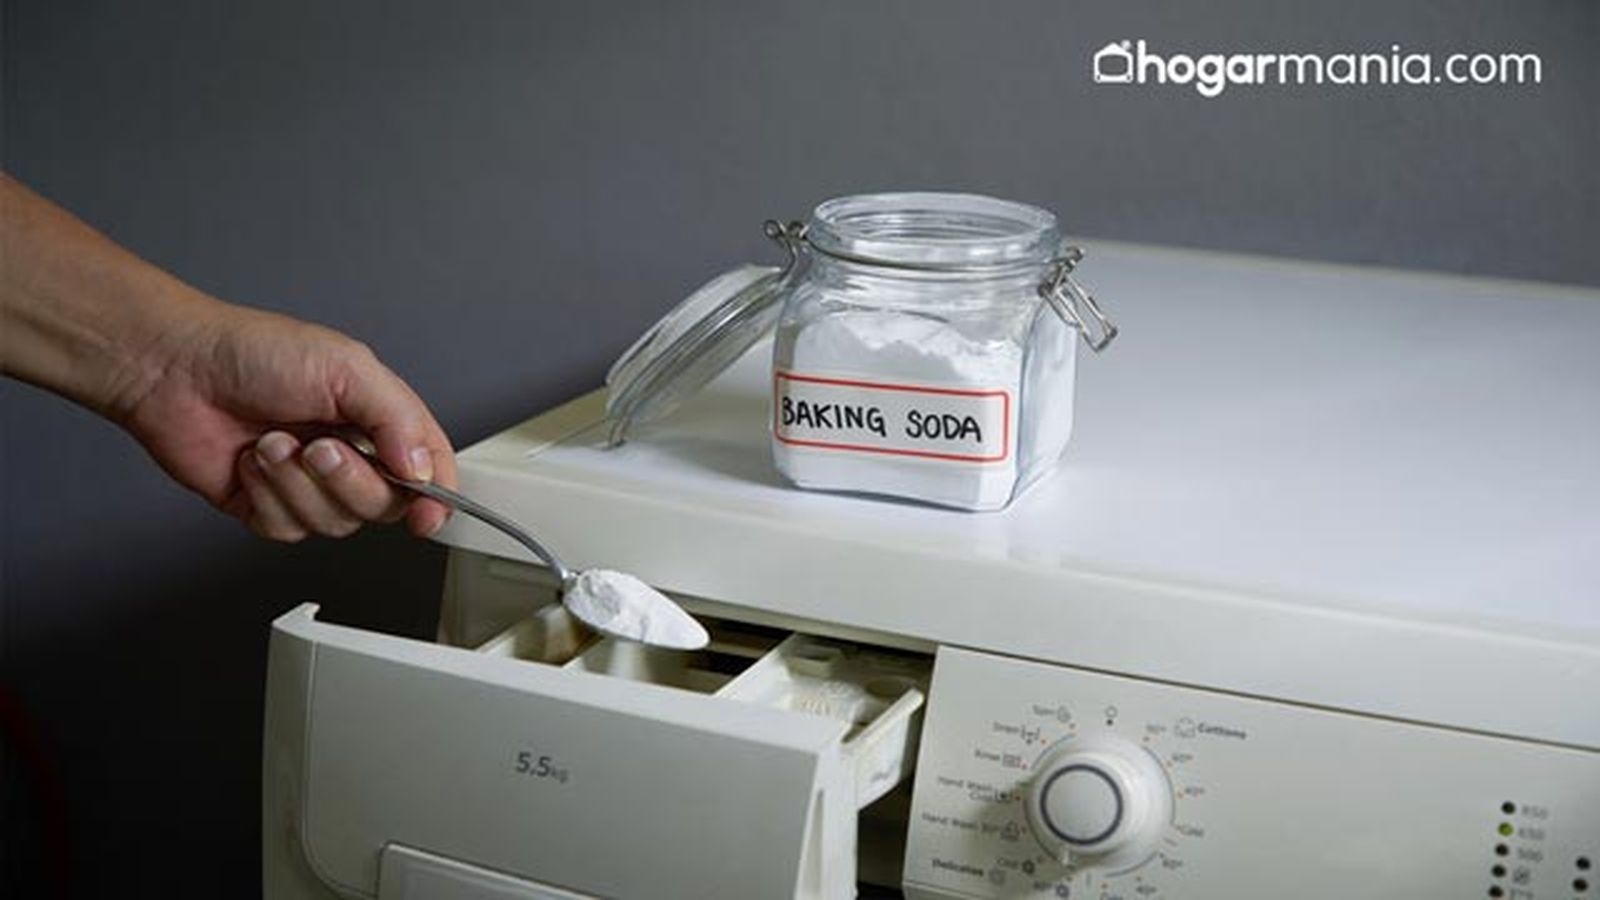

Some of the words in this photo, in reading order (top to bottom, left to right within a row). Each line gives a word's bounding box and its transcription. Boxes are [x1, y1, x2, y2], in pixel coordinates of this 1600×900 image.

[781, 396, 887, 438] BAKING
[905, 408, 983, 443] SODA
[1198, 721, 1247, 741] Cottons
[931, 857, 984, 877] Delicates
